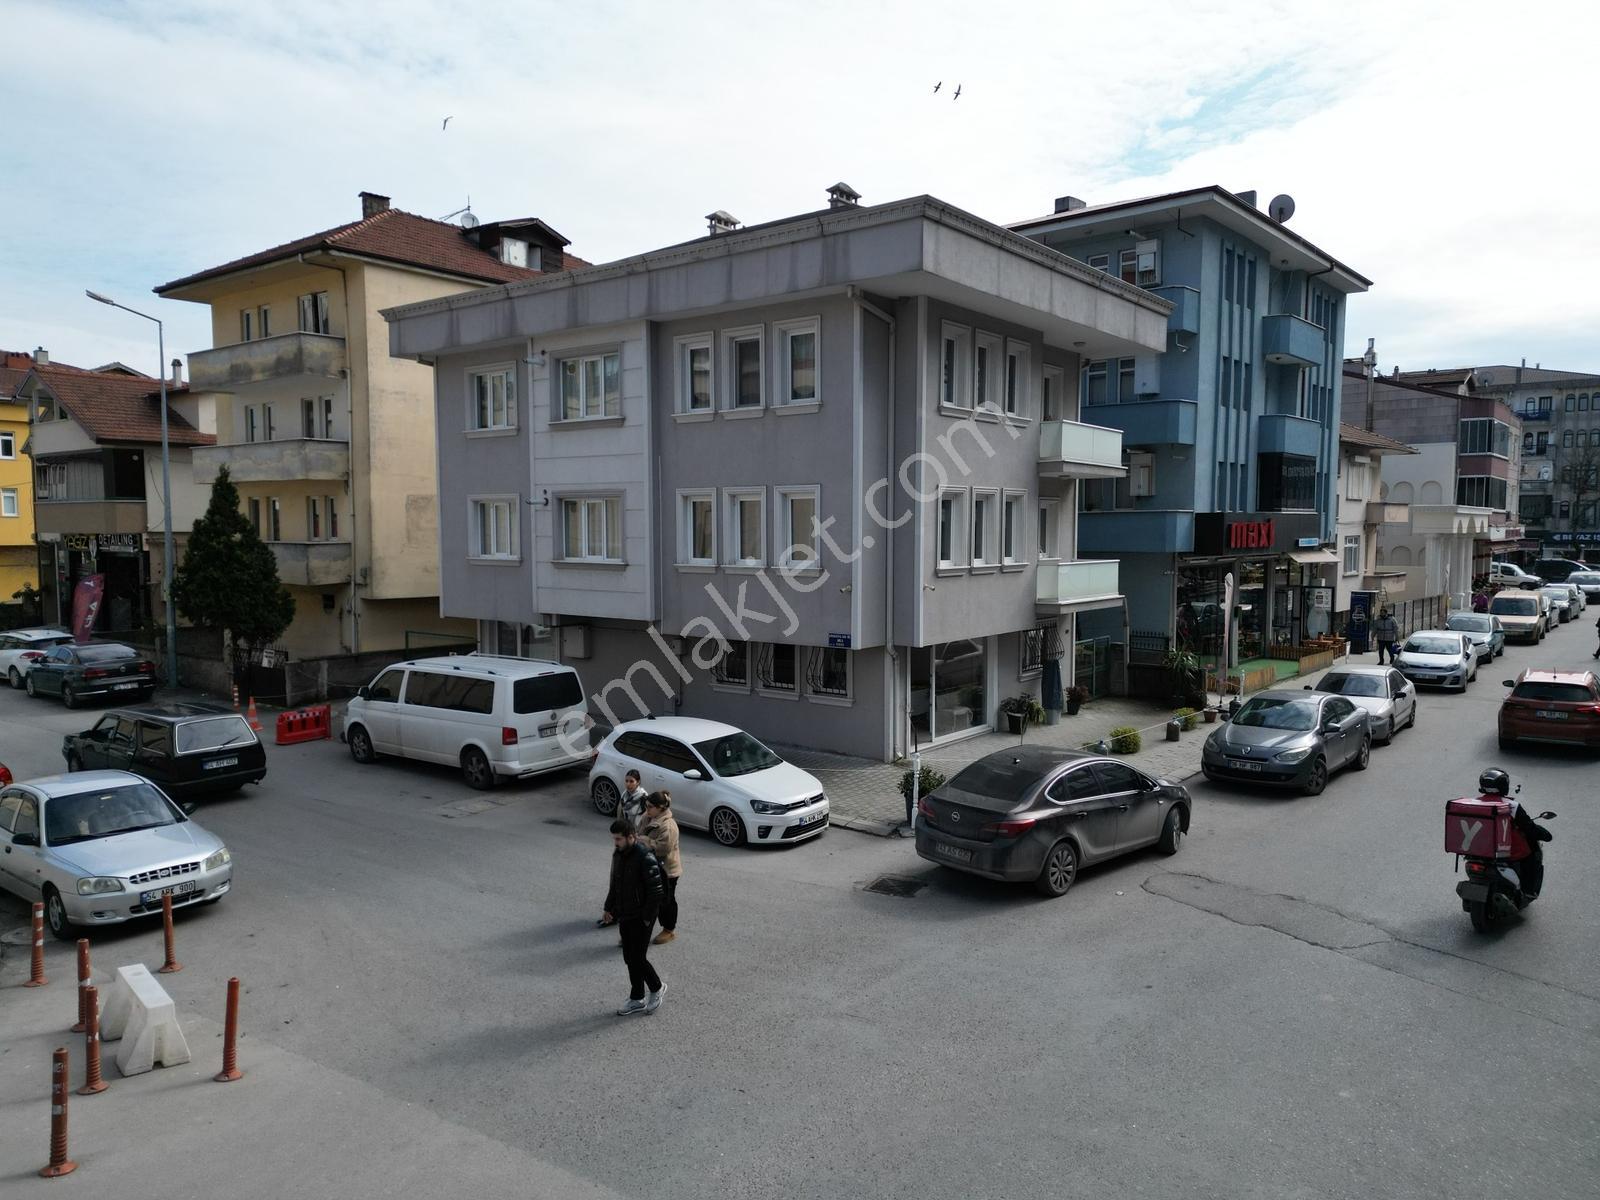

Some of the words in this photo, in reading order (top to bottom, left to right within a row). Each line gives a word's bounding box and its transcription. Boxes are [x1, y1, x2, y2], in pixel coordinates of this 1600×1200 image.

[98, 534, 134, 545] DETAILING
[1460, 819, 1483, 851] Y
[180, 882, 194, 893] 900
